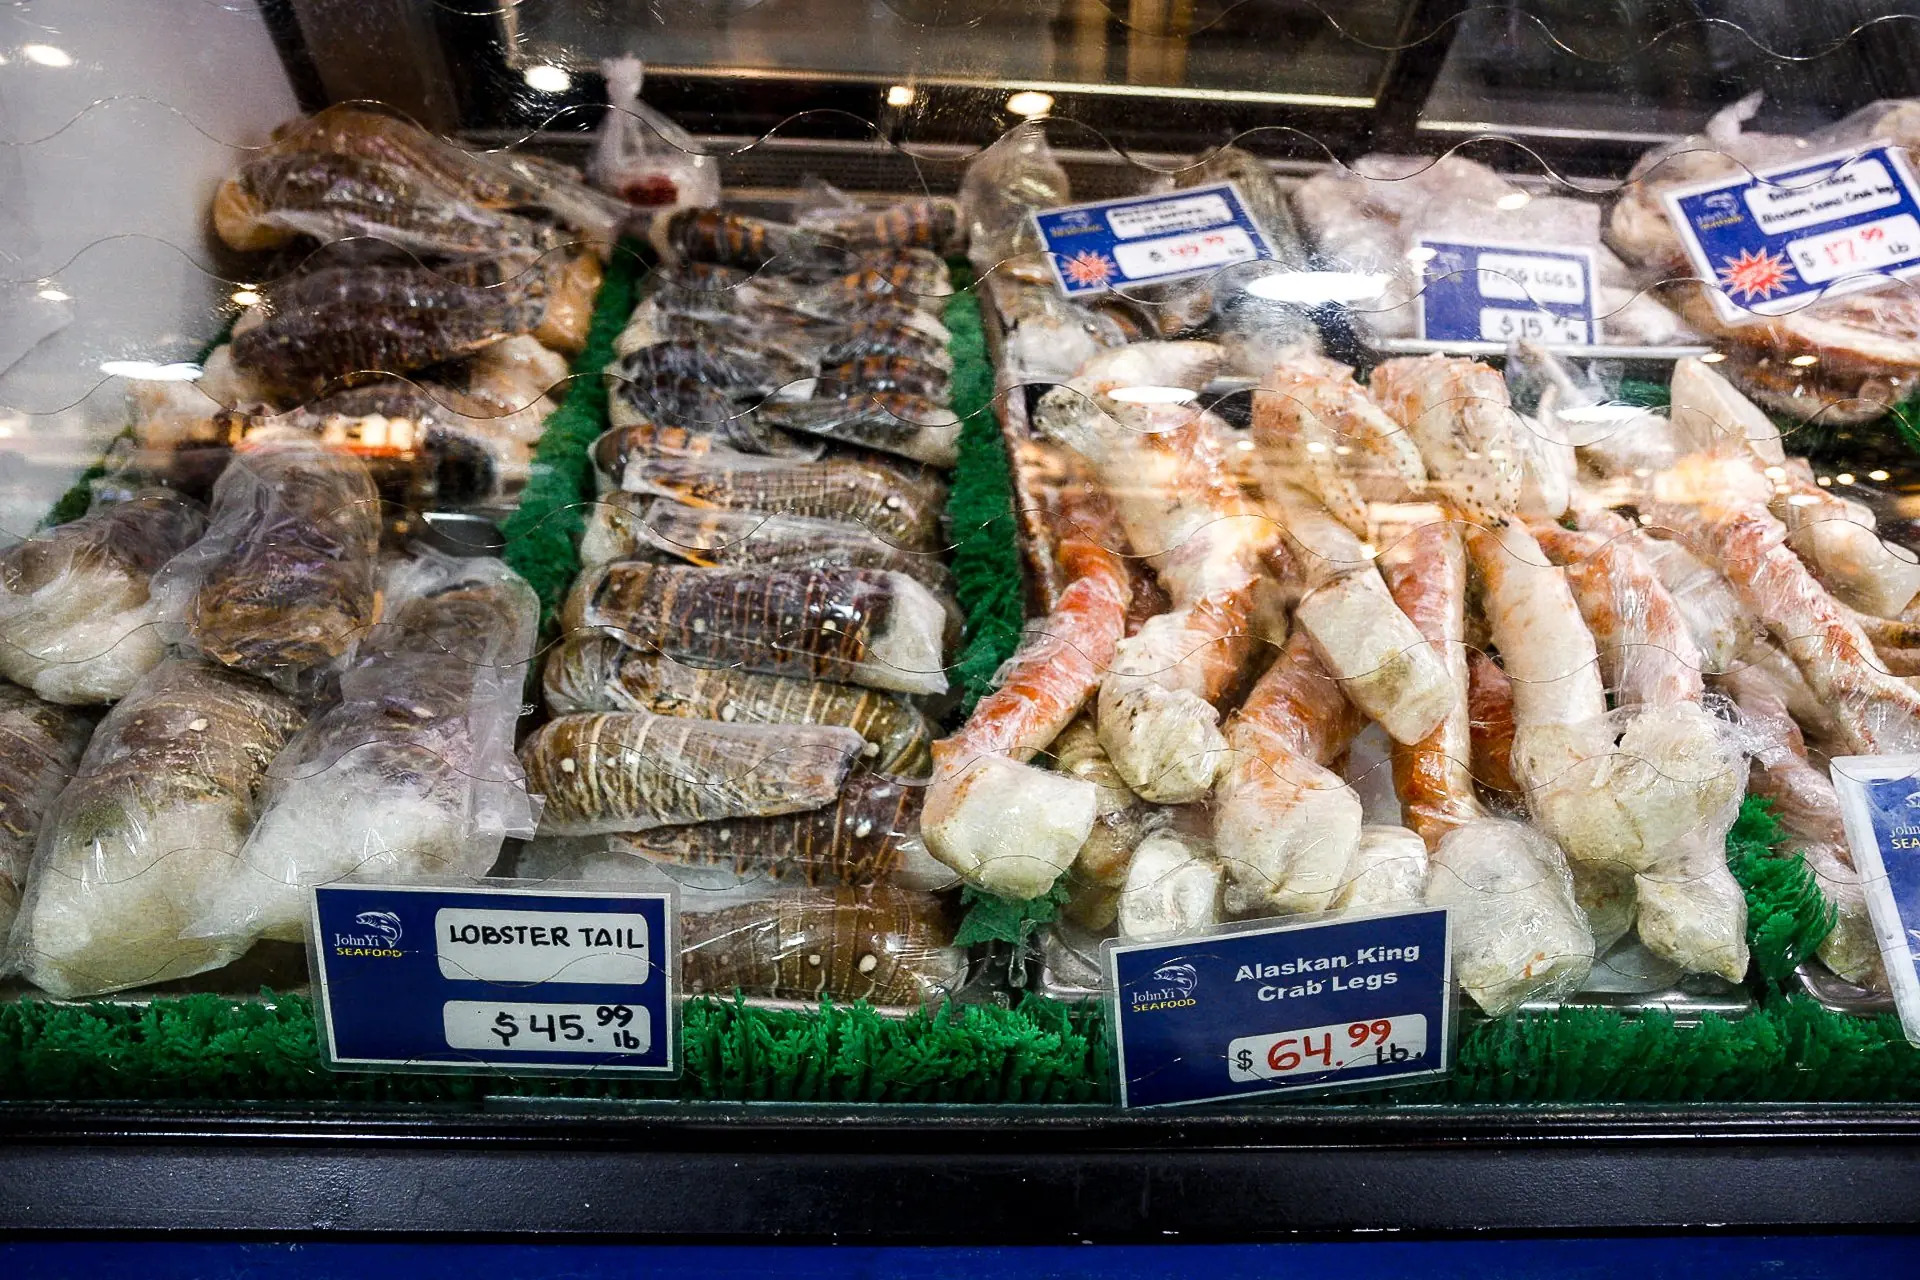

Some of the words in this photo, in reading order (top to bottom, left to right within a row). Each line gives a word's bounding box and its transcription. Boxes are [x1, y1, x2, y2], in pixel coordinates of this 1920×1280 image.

[450, 925, 569, 947] LOBSTER
[578, 926, 645, 949] TAIL
[336, 948, 402, 957] SEAFOOD
[1234, 957, 1346, 983] Alaskan
[1357, 945, 1421, 965] King
[1257, 981, 1323, 1002] Crab
[1332, 971, 1399, 992] Legs
[1133, 998, 1197, 1013] SEAFOOD
